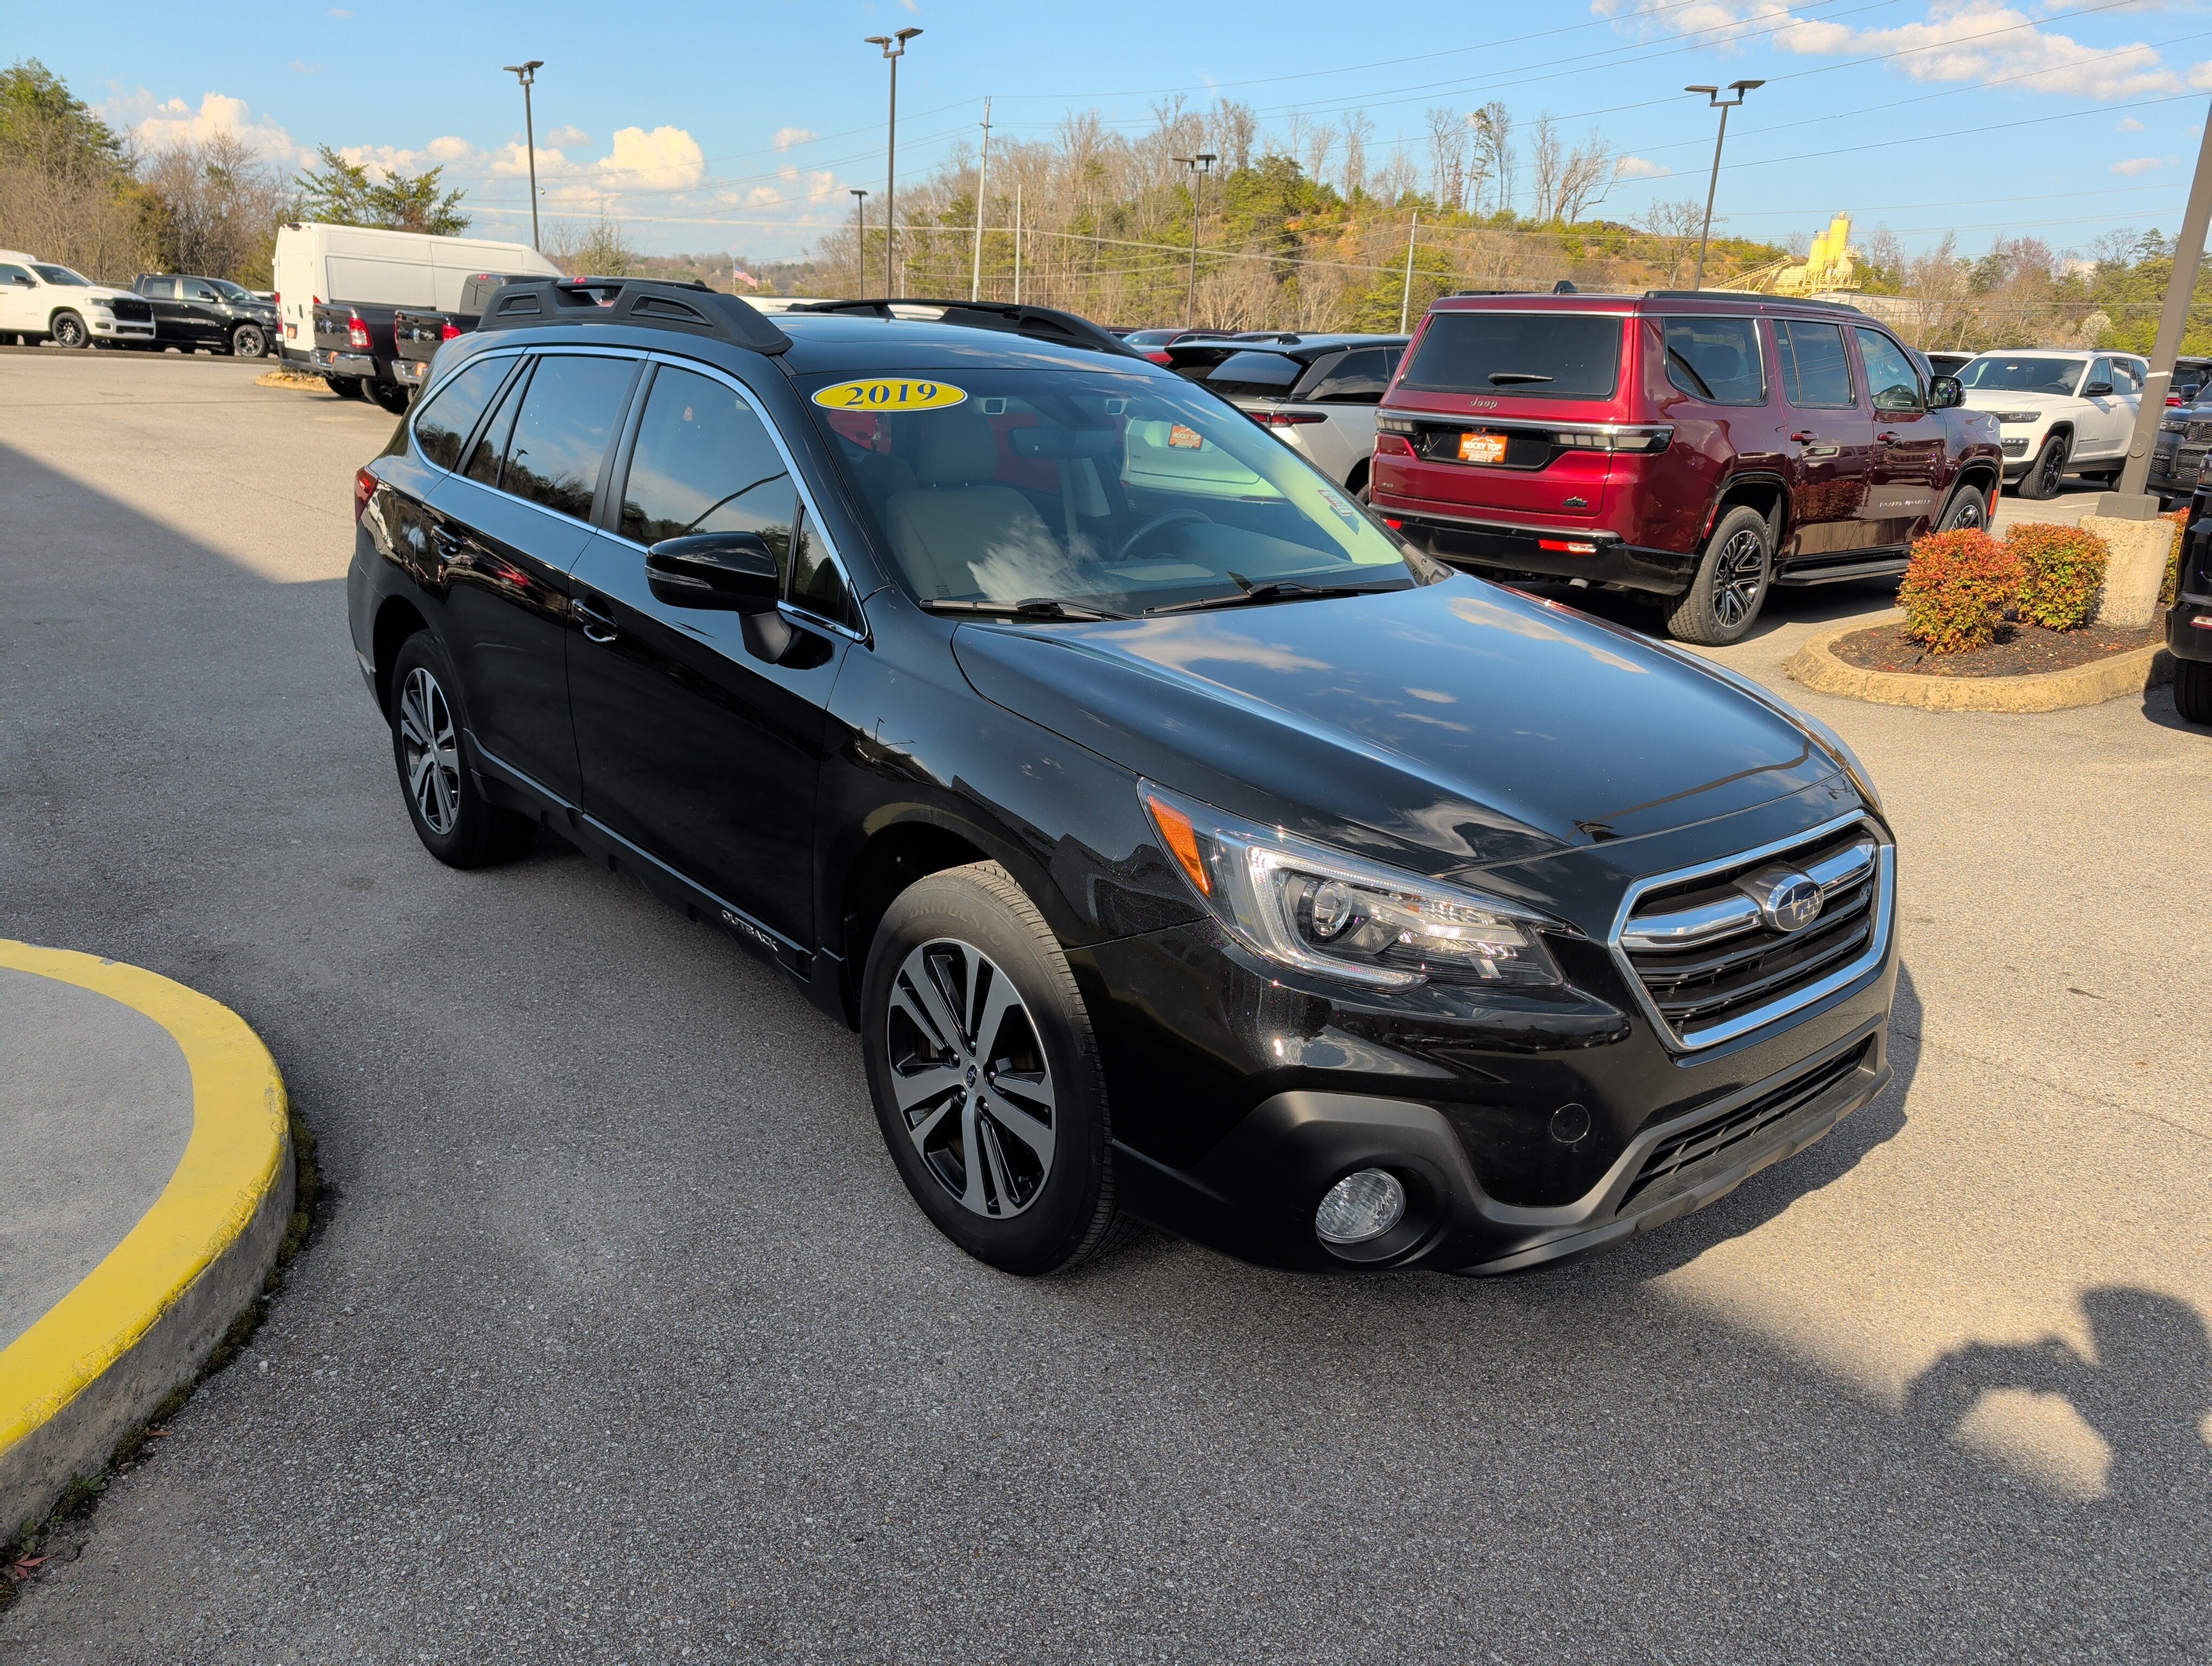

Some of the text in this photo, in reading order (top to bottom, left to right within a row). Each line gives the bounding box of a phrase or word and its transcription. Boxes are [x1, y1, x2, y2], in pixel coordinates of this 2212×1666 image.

[844, 383, 937, 406] 2019
[1469, 397, 1497, 409] Jeep
[1463, 441, 1487, 450] ROCKY
[722, 909, 778, 952] OUTBACK
